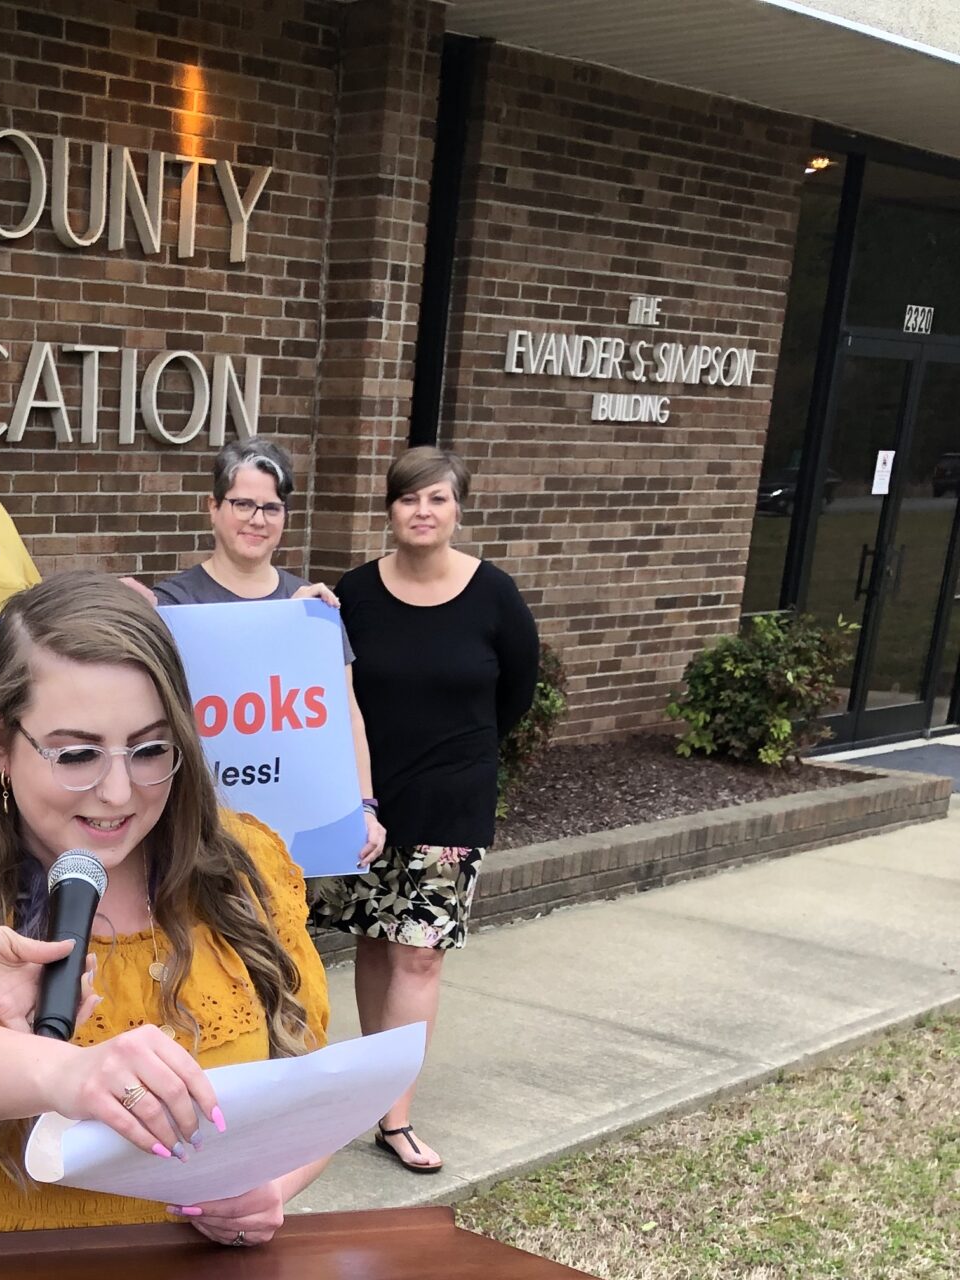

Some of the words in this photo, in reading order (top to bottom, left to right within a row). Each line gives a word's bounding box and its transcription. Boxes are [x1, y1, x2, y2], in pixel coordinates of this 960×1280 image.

[628, 296, 662, 325] THE
[904, 305, 933, 333] 2320
[505, 330, 625, 380] EVANDER
[624, 340, 648, 383] S.
[649, 342, 756, 387] SIMPSON
[591, 393, 670, 424] BUILDING
